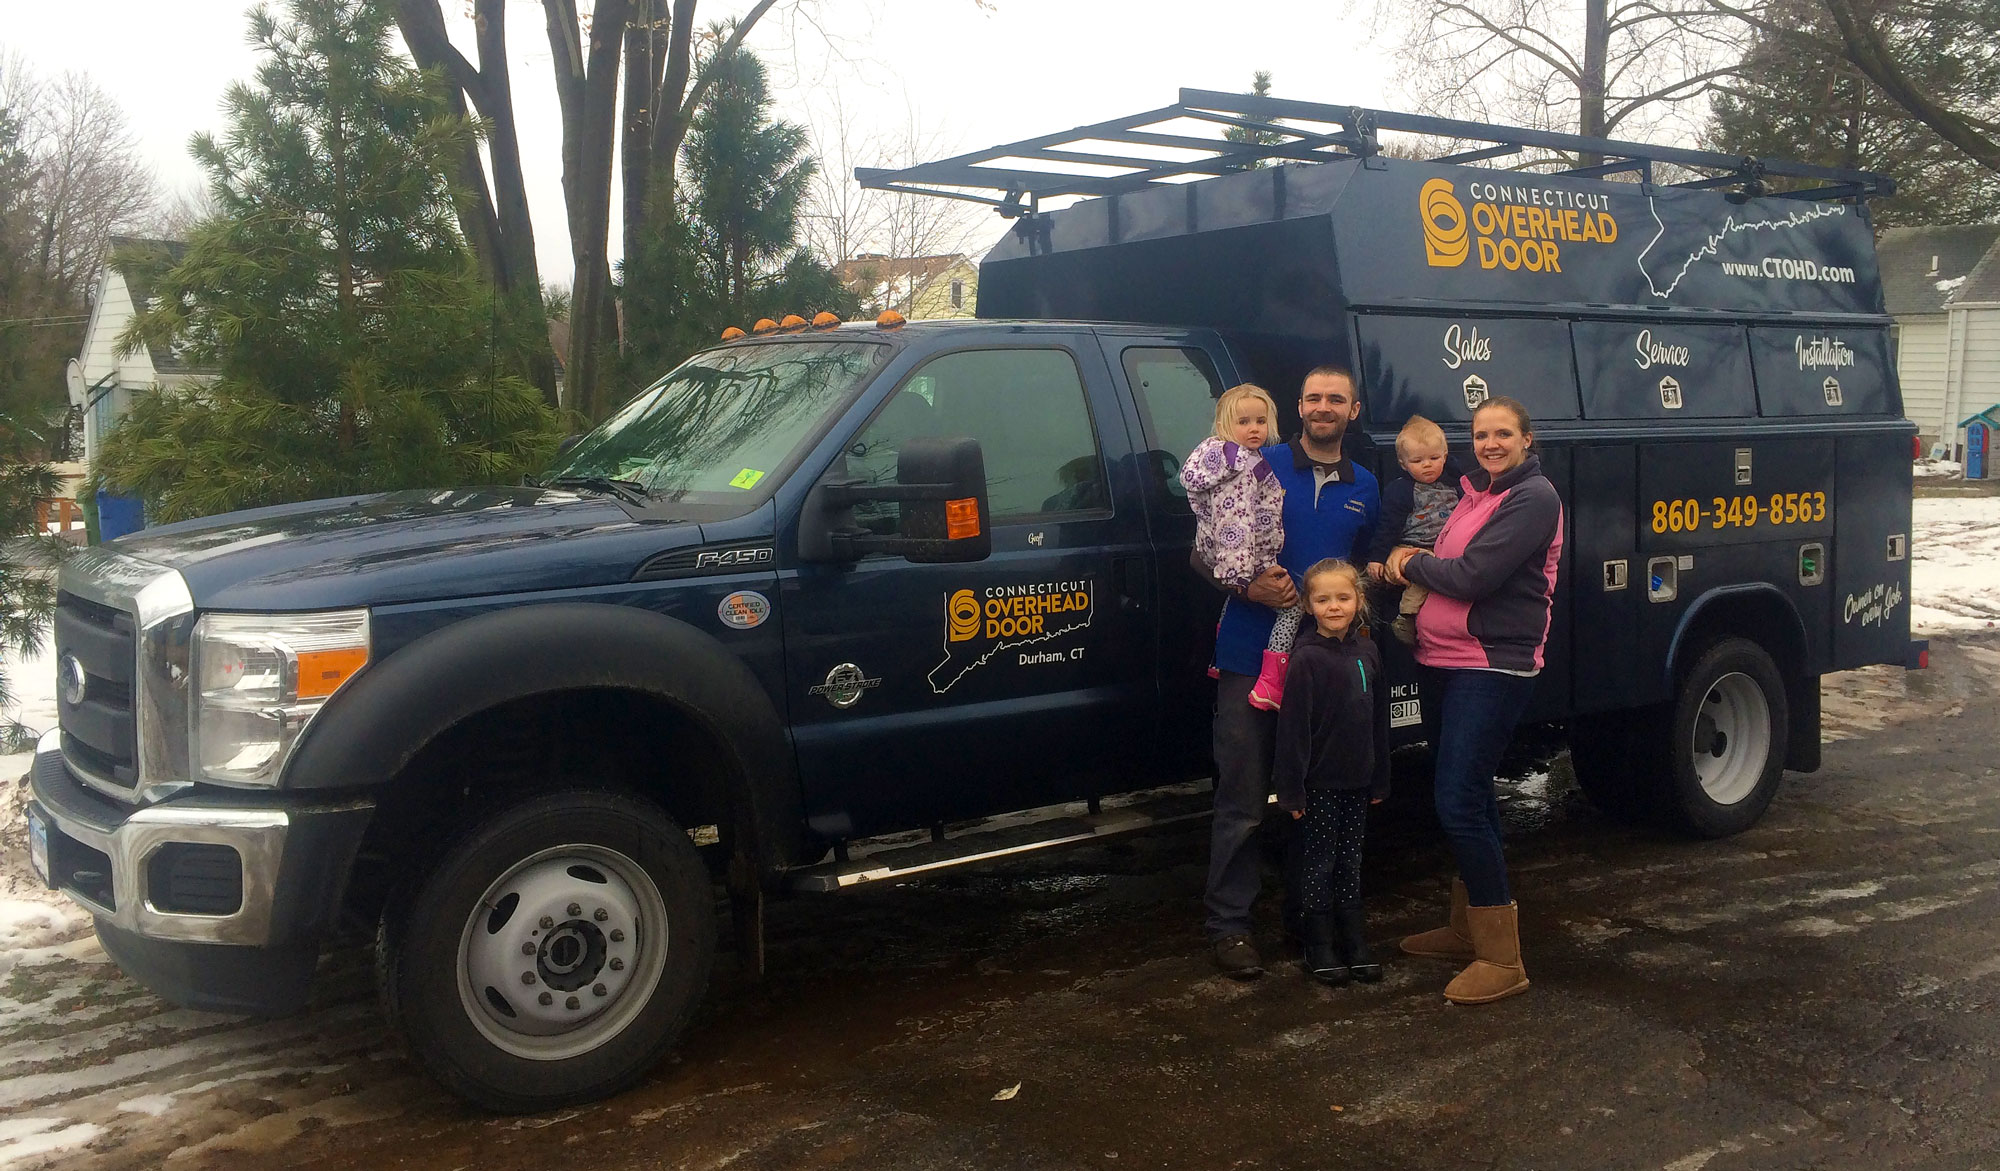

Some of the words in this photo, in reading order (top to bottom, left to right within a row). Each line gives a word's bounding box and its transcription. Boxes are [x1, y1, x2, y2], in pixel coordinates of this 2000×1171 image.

[1469, 182, 1611, 211] CONNECTICUT
[1472, 202, 1618, 244] OVERHEAD
[1477, 235, 1562, 273] DOOR
[1721, 257, 1856, 283] www.CTOHD.com
[1442, 323, 1492, 370] Sales
[1634, 328, 1690, 370] Service
[1794, 334, 1856, 372] Installation
[1651, 491, 1827, 535] 860-349-8563
[695, 547, 774, 569] F-450
[985, 580, 1086, 598] CONNECTICUT
[1874, 583, 1885, 600] on
[728, 601, 761, 610] CERTIFIED
[984, 591, 1088, 619] OVERHEAD
[1862, 602, 1882, 628] every
[986, 615, 1044, 639] DOOR
[1018, 651, 1066, 666] Durham,
[1070, 647, 1085, 660] CT
[1390, 684, 1407, 698] HIC
